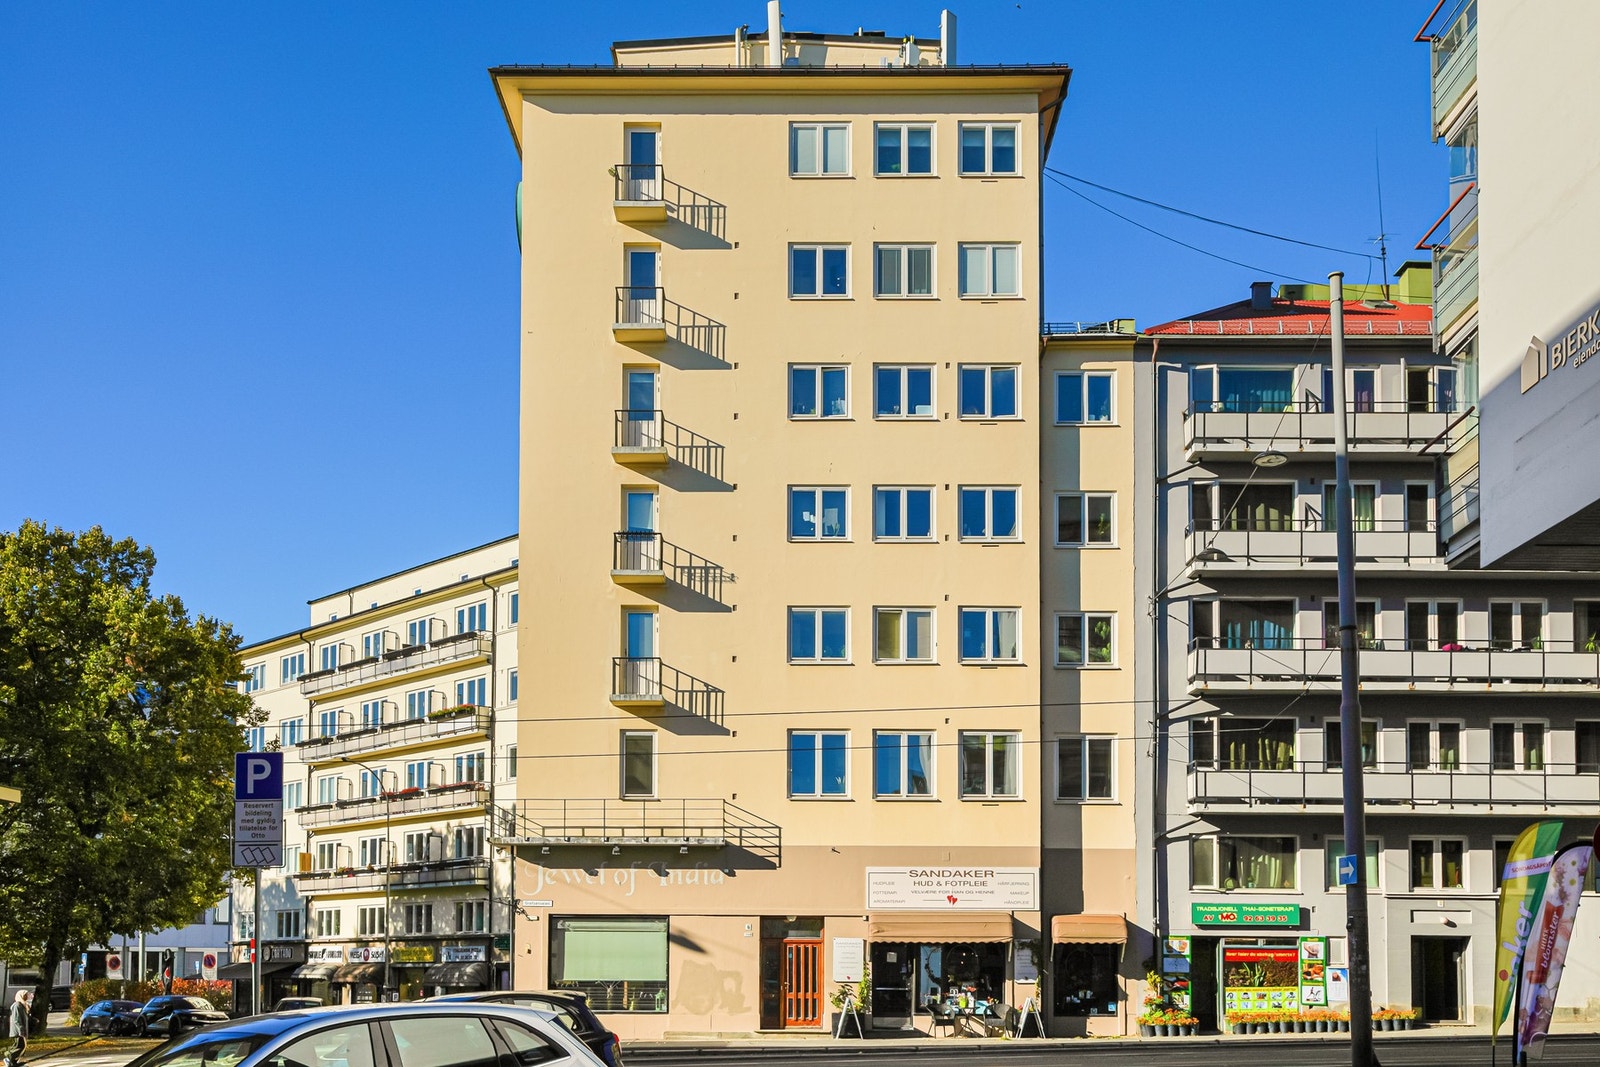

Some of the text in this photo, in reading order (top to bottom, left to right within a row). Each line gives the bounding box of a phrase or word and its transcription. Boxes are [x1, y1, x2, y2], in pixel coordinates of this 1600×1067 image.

[247, 759, 272, 794] P
[520, 861, 725, 897] Jewel of India
[909, 869, 995, 878] SANDAKER
[1220, 912, 1237, 921] MO
[1541, 911, 1559, 969] blomster
